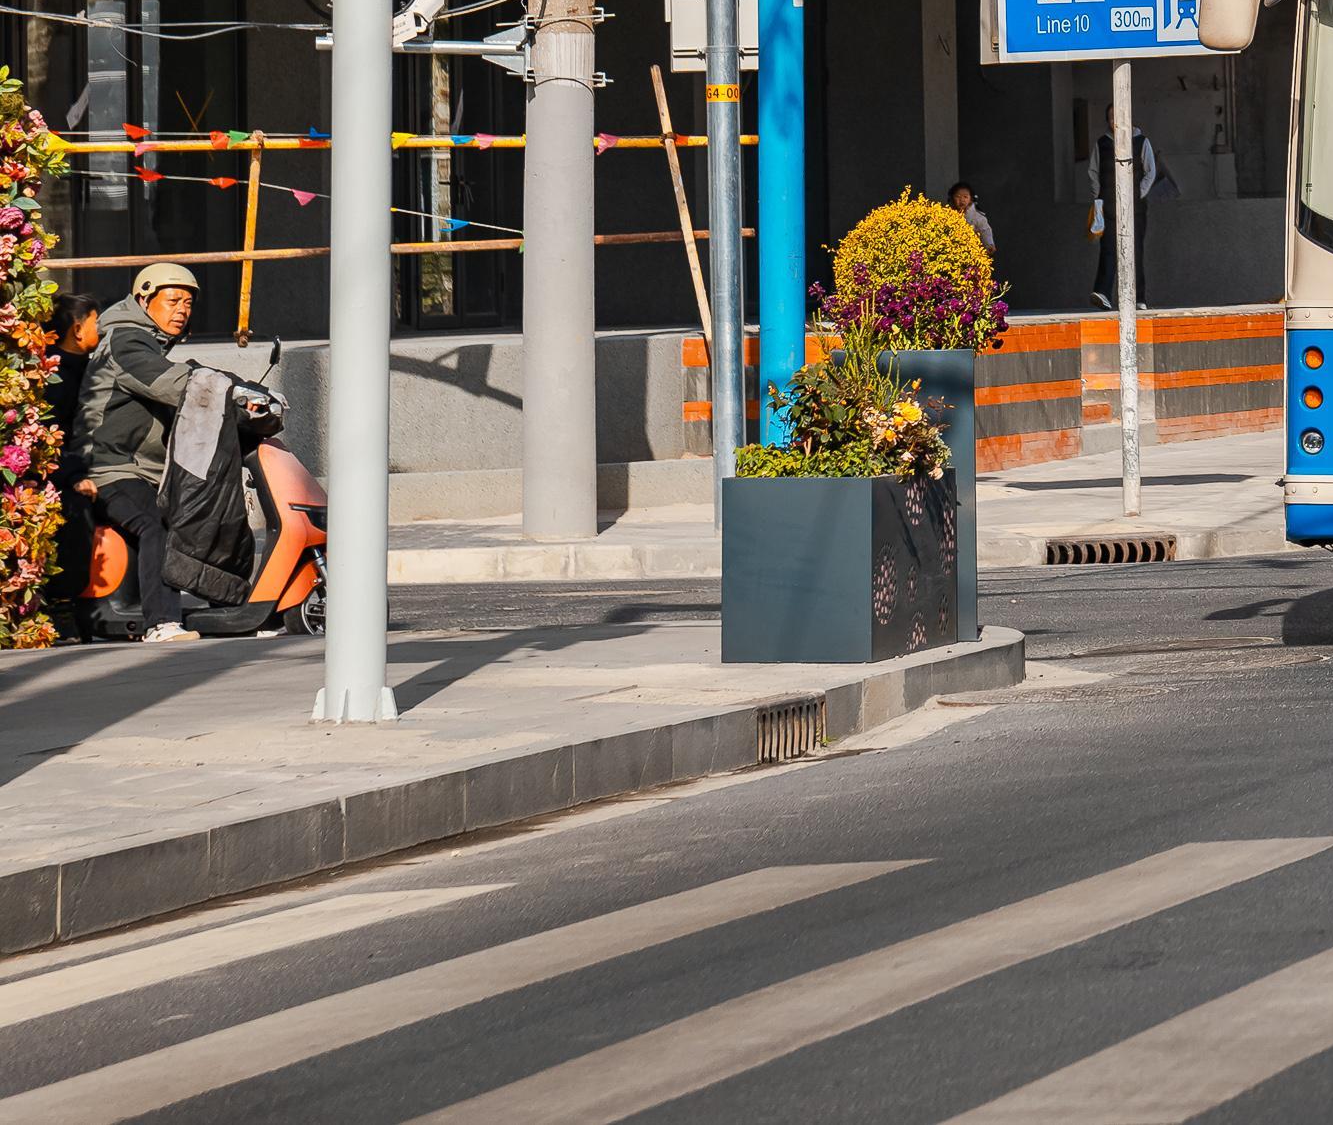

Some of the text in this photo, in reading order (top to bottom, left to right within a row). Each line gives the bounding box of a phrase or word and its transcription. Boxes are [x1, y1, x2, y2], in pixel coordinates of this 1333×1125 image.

[1037, 14, 1090, 34] Line 10
[1114, 10, 1151, 28] 300m
